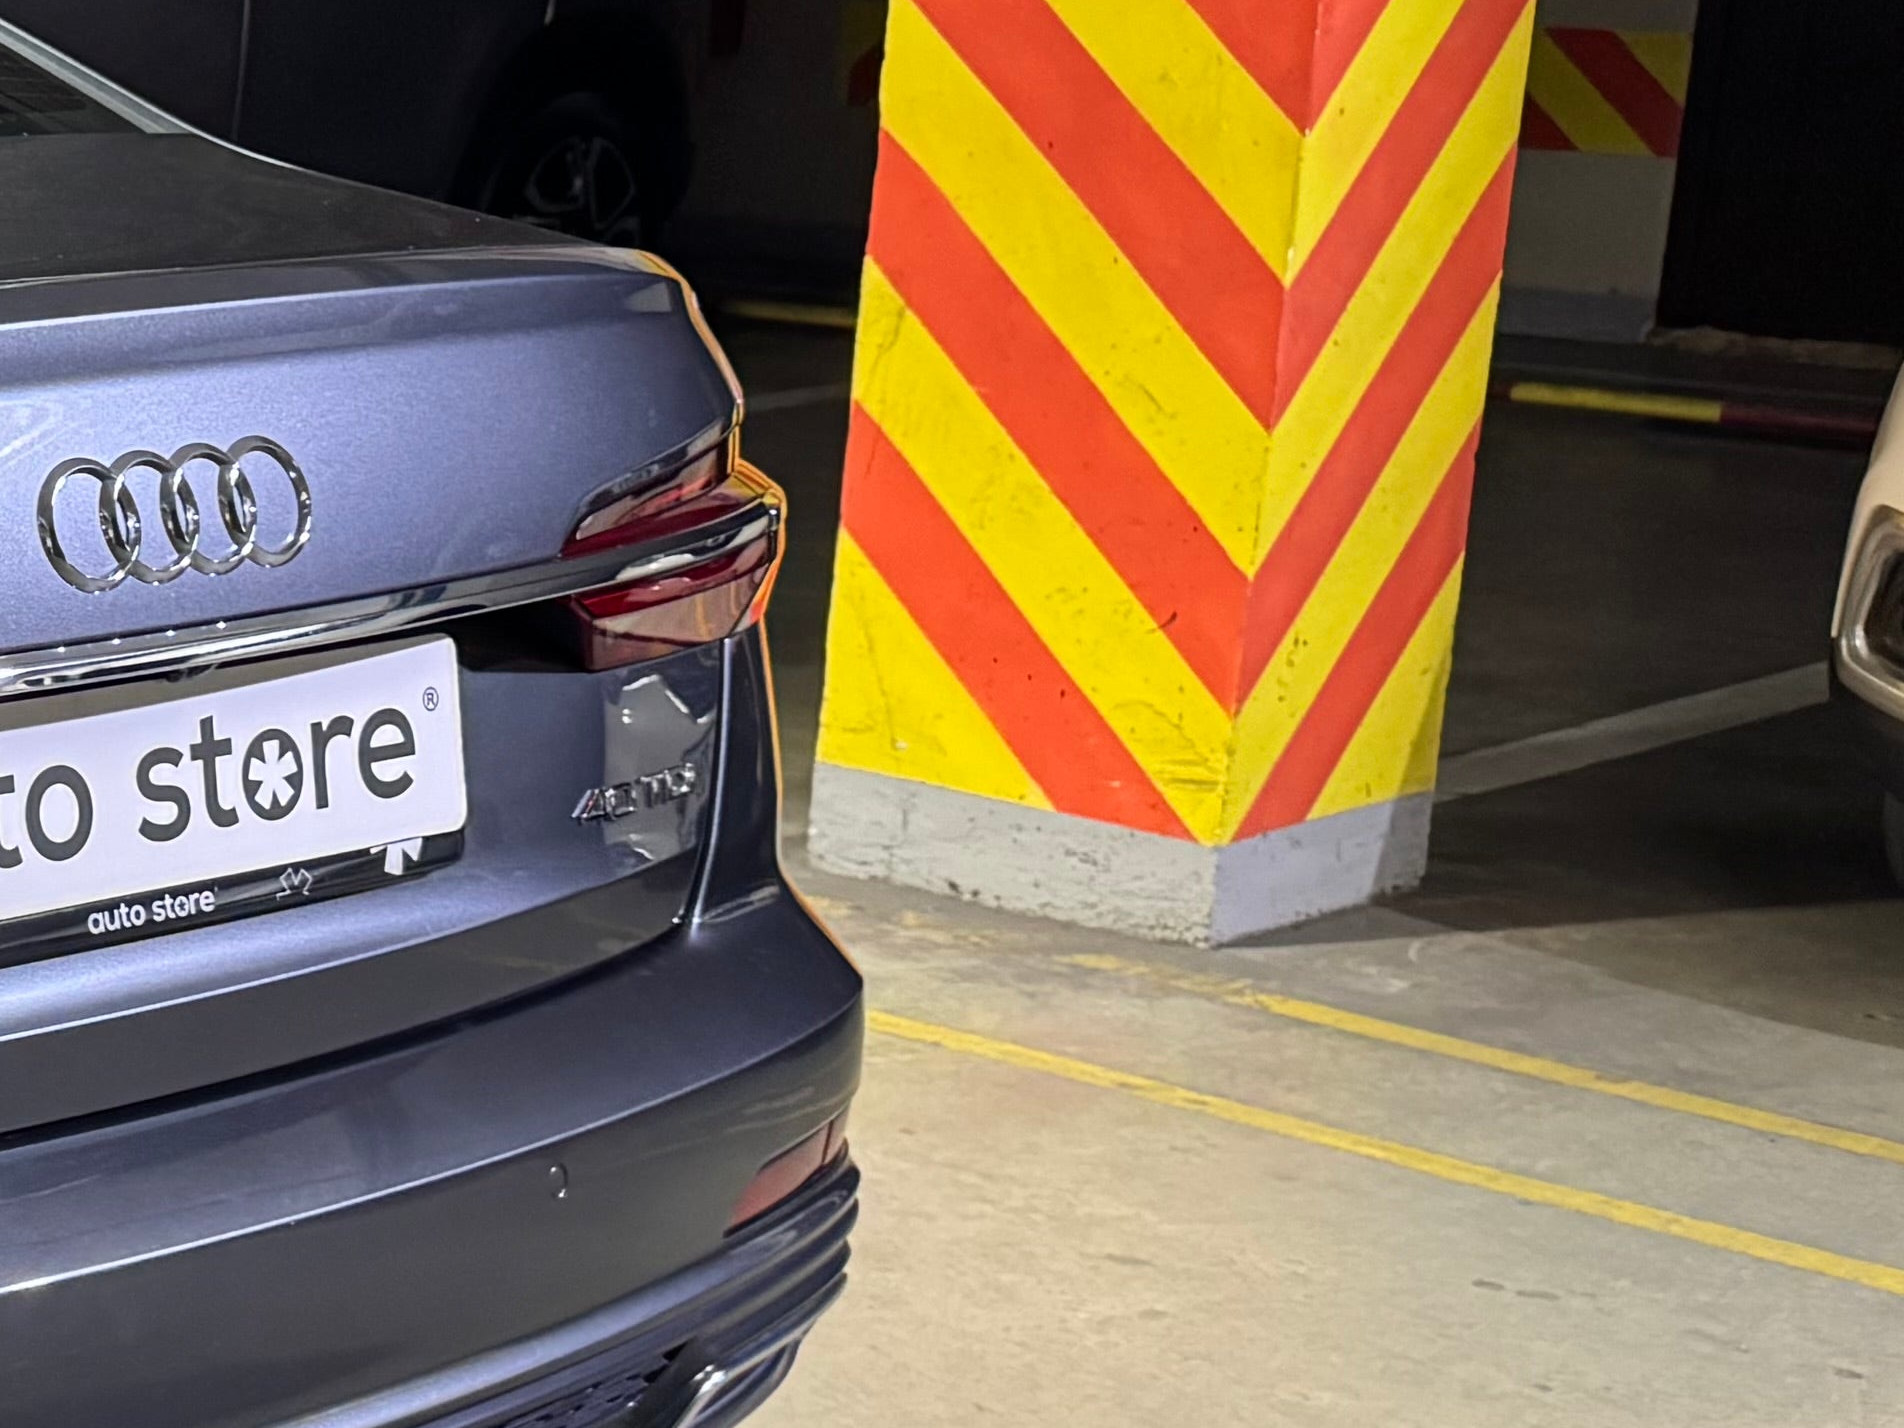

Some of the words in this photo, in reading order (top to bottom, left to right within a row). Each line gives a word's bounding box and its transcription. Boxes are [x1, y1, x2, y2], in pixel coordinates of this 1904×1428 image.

[137, 706, 416, 843] store
[87, 902, 146, 935] auto
[151, 889, 217, 922] store
